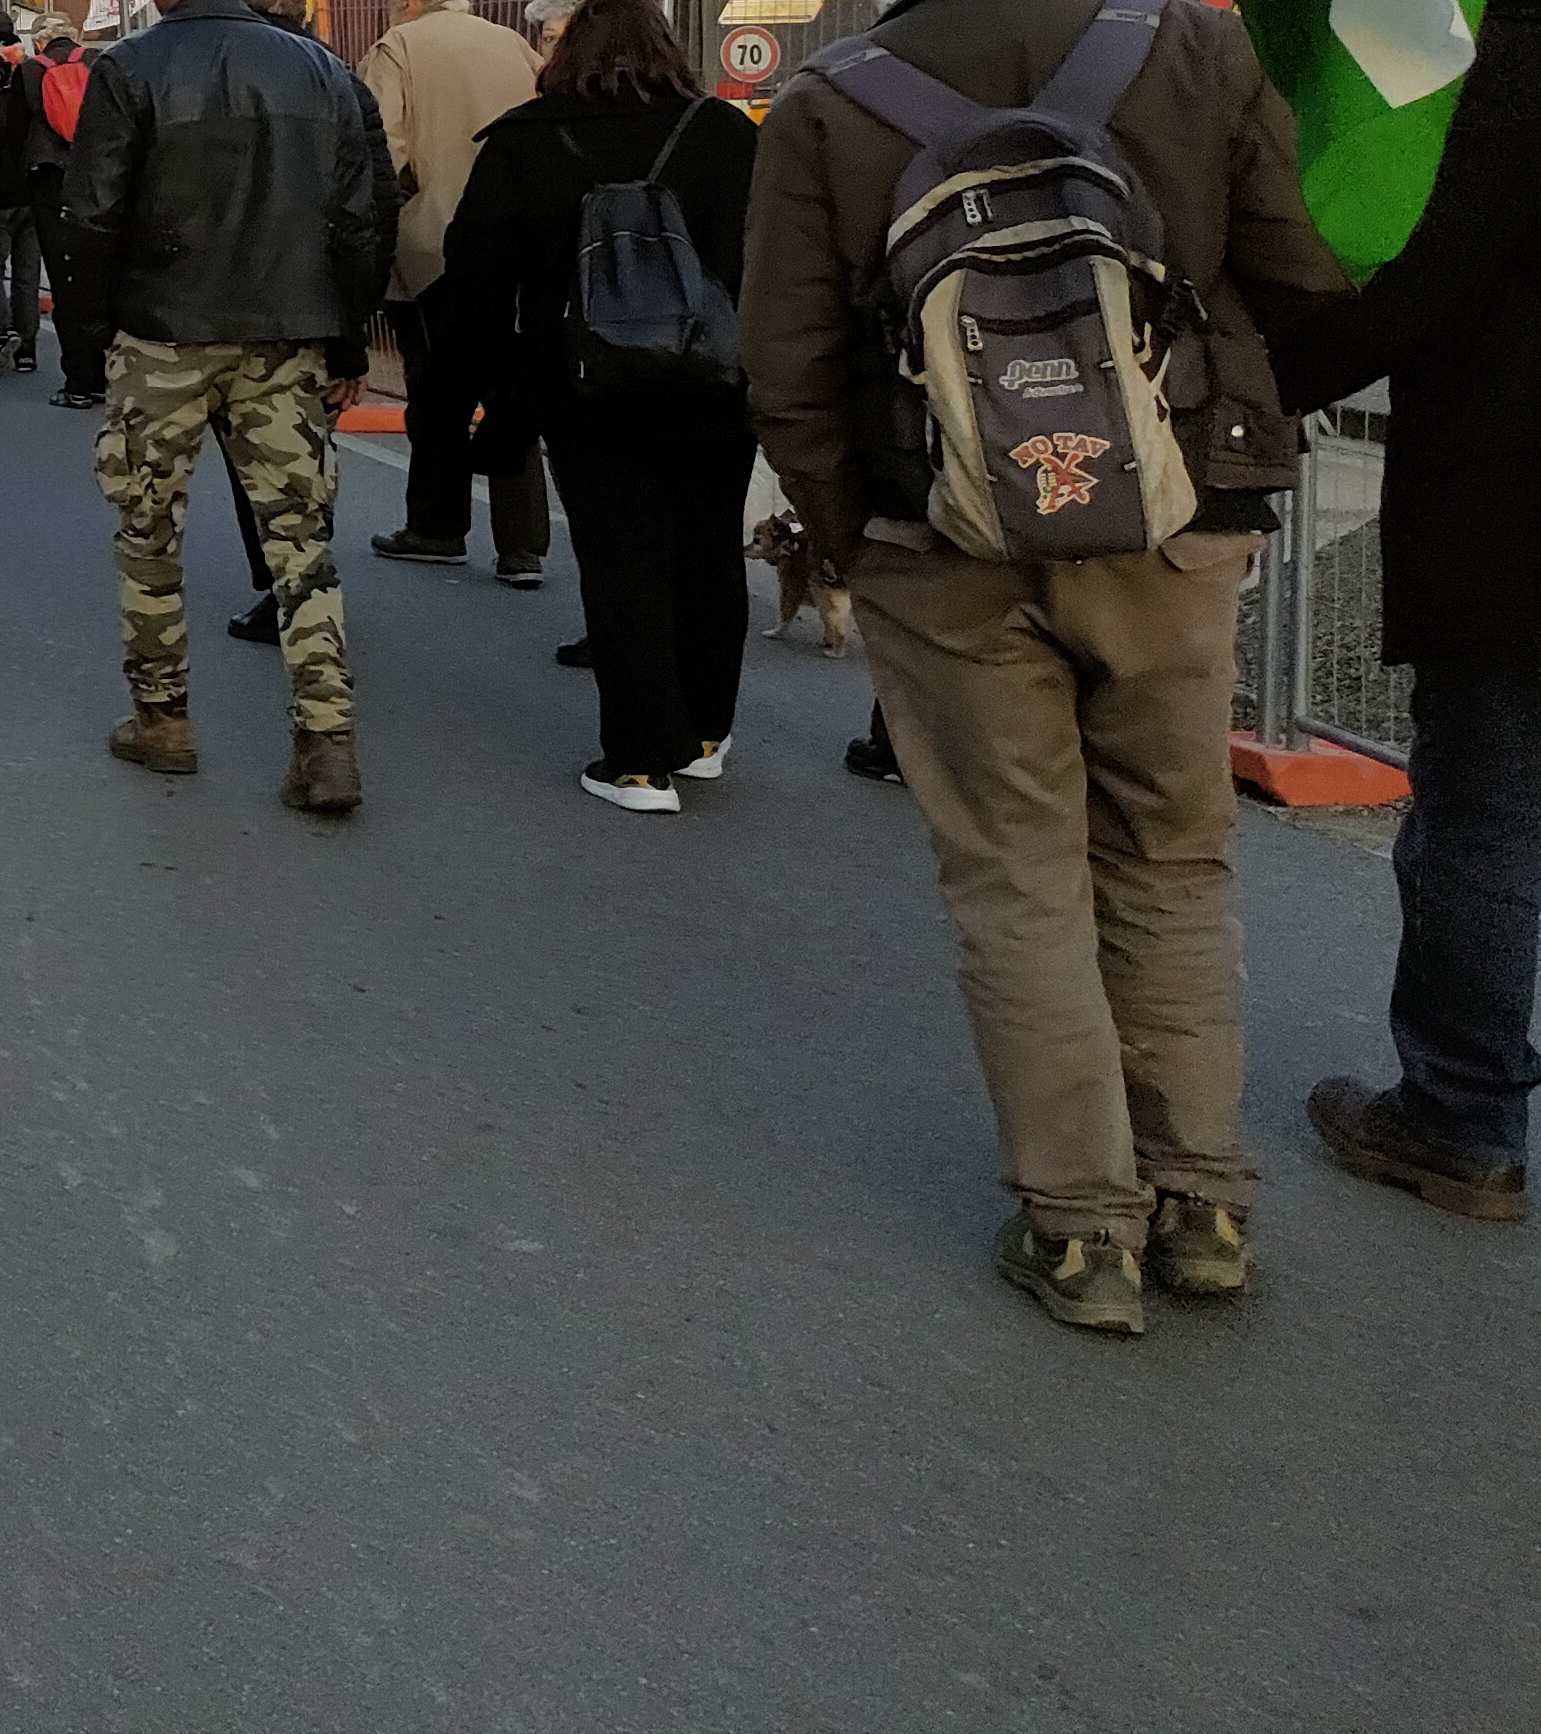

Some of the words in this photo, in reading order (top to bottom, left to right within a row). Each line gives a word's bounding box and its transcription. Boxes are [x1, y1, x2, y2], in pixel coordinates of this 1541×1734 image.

[737, 44, 762, 66] 70
[1010, 436, 1054, 468] NO
[1053, 433, 1111, 458] TAV
